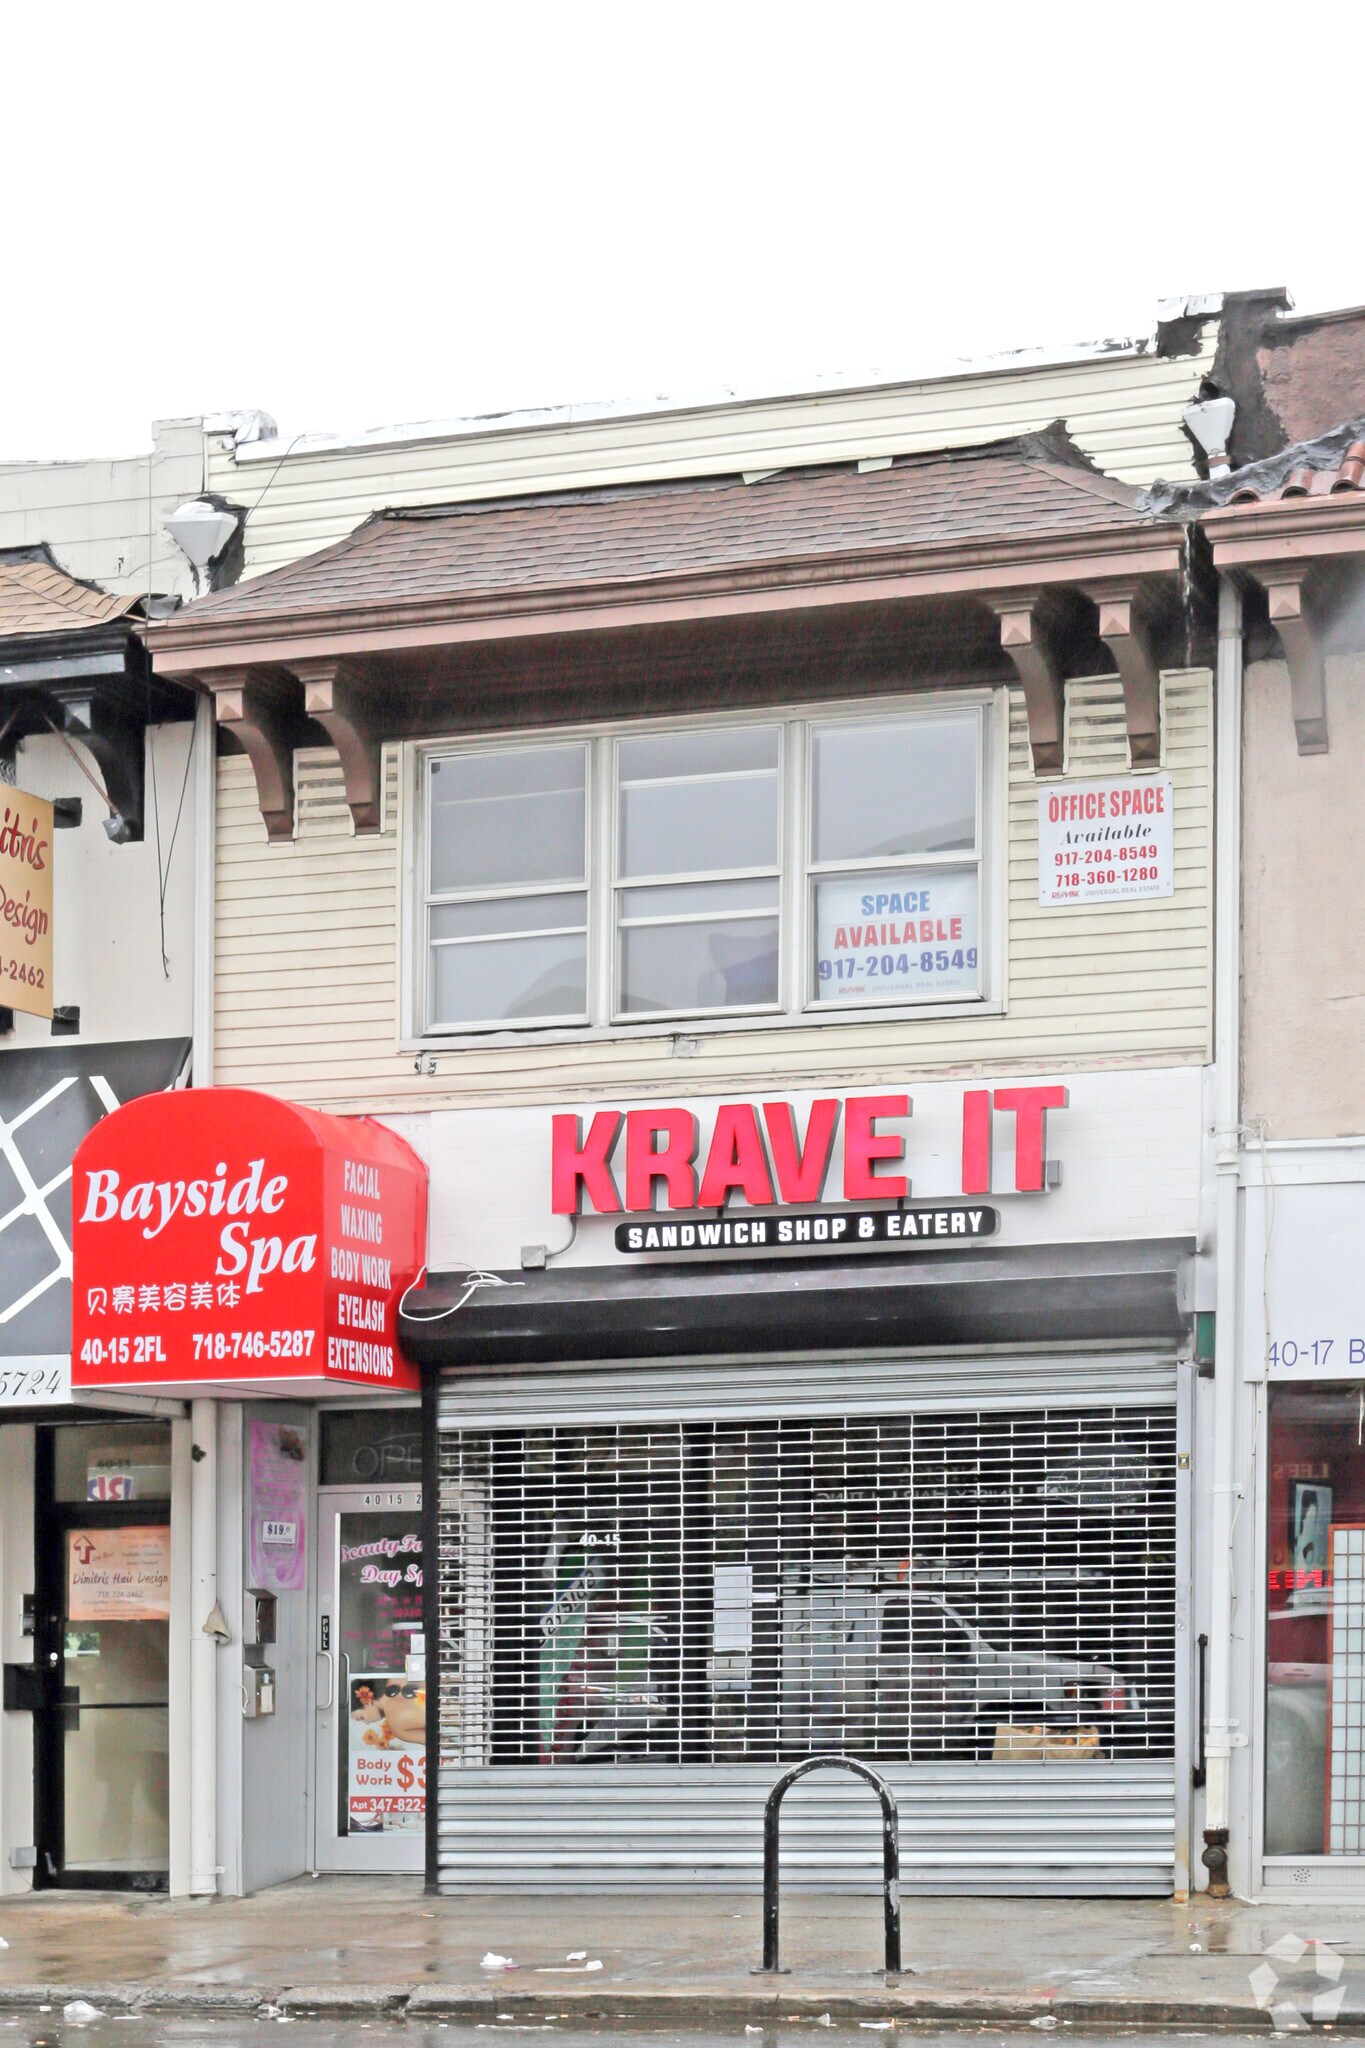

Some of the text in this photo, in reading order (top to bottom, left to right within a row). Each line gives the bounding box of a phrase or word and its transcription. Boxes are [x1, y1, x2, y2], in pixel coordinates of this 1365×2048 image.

[1048, 786, 1165, 823] OFFICE SPACE
[1060, 823, 1152, 845] Available
[1054, 844, 1158, 867] 917-204-8549
[1056, 866, 1158, 888] 718-360-1280
[1084, 889, 1120, 897] UNIVERSAL
[1121, 886, 1138, 894] REAL
[1139, 884, 1161, 892] ESTATE
[861, 890, 930, 916] SPACE
[834, 917, 962, 950] AVAILABLE
[819, 947, 978, 981] 917-204-8549
[551, 1085, 1069, 1215] KRAVE IT
[344, 1160, 380, 1200] FACIAL
[79, 1158, 289, 1240] Bayside
[341, 1204, 383, 1245] WAXING
[628, 1211, 983, 1249] SANDWICH SHOP & EATERY
[215, 1221, 318, 1295] Spa
[331, 1246, 391, 1290] BODY WORK
[87, 1280, 241, 1316] 贝赛美容美体
[338, 1293, 385, 1332] EYELASH
[80, 1336, 166, 1365] 40-15 2FL
[192, 1330, 315, 1361] 718-746-5287
[328, 1336, 394, 1377] EXTENSIONS
[1268, 1339, 1334, 1367] 40-17
[0, 1369, 61, 1396] 5724
[340, 1538, 400, 1563] Beauty
[579, 1533, 621, 1547] 40-15
[73, 1570, 169, 1588] Dimitris Hair Design
[360, 1564, 402, 1588] Day
[357, 1758, 391, 1772] Body
[356, 1774, 393, 1786] Work
[352, 1801, 368, 1810] Apt
